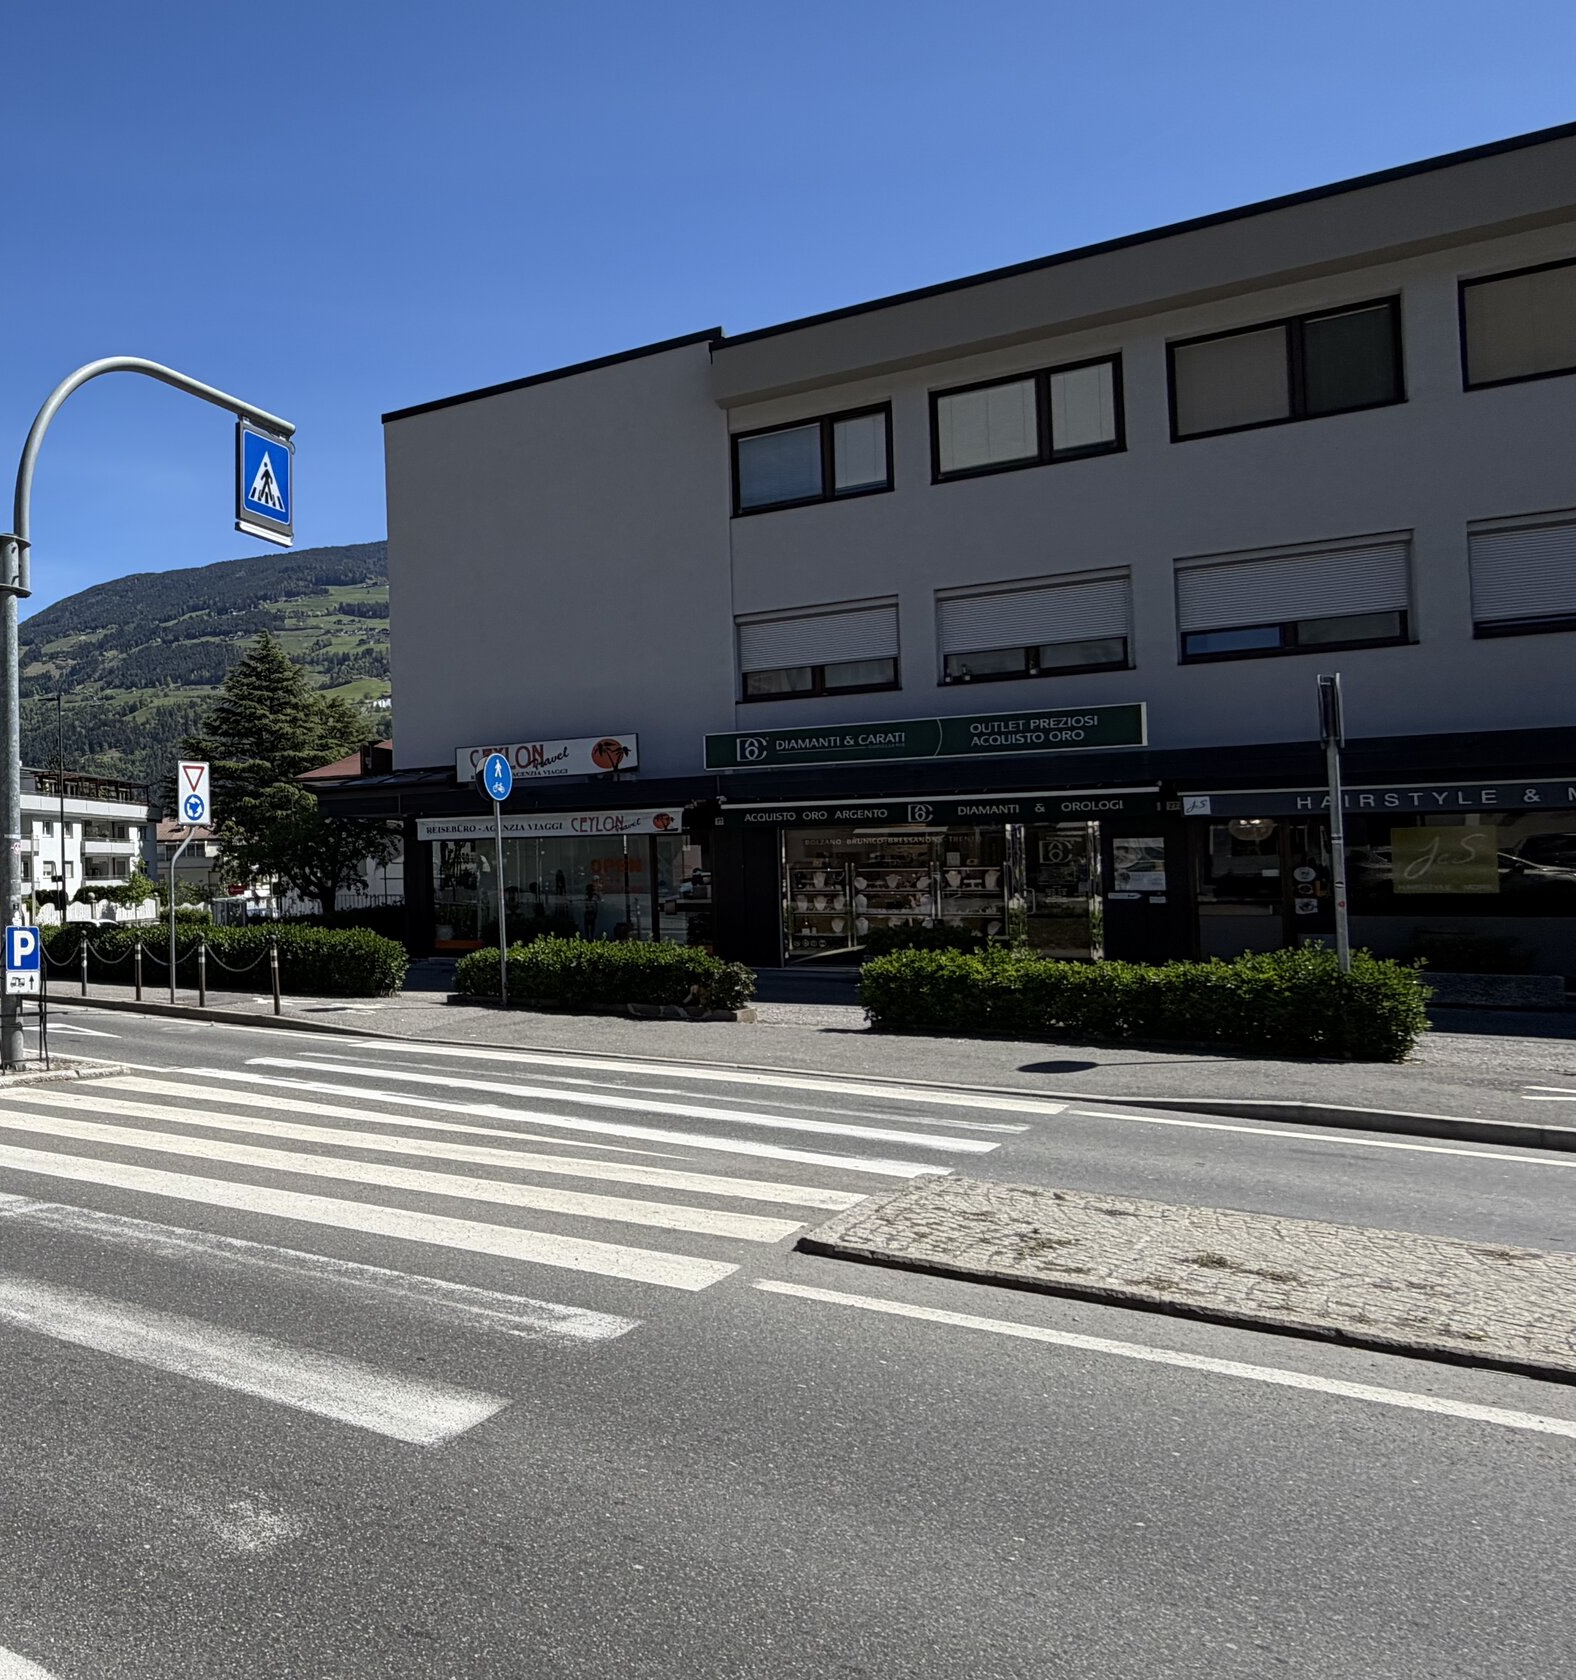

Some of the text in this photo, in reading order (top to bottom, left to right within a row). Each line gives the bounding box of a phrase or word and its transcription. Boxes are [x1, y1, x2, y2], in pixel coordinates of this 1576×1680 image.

[969, 715, 1098, 733] OUTLET PREZIOSI
[776, 736, 840, 750] DIAMANTI
[844, 736, 855, 745] &
[858, 732, 905, 745] CARATI
[971, 730, 1084, 746] ACQUISTO ORO
[1297, 789, 1497, 809] HAIRSTYLE
[1524, 789, 1541, 803] &
[744, 811, 796, 822] ACQUISTO
[802, 811, 827, 820] ORO
[834, 809, 887, 819] ARGENTO
[958, 804, 1019, 816] DIAMANTI
[1035, 803, 1045, 813] &
[1061, 800, 1123, 812] OROLOGI
[426, 824, 476, 834] REISEBÜRO
[483, 824, 525, 833] AGNZIA
[528, 822, 563, 831] VIAGGI
[571, 815, 624, 833] CEYLON
[13, 930, 35, 967] P
